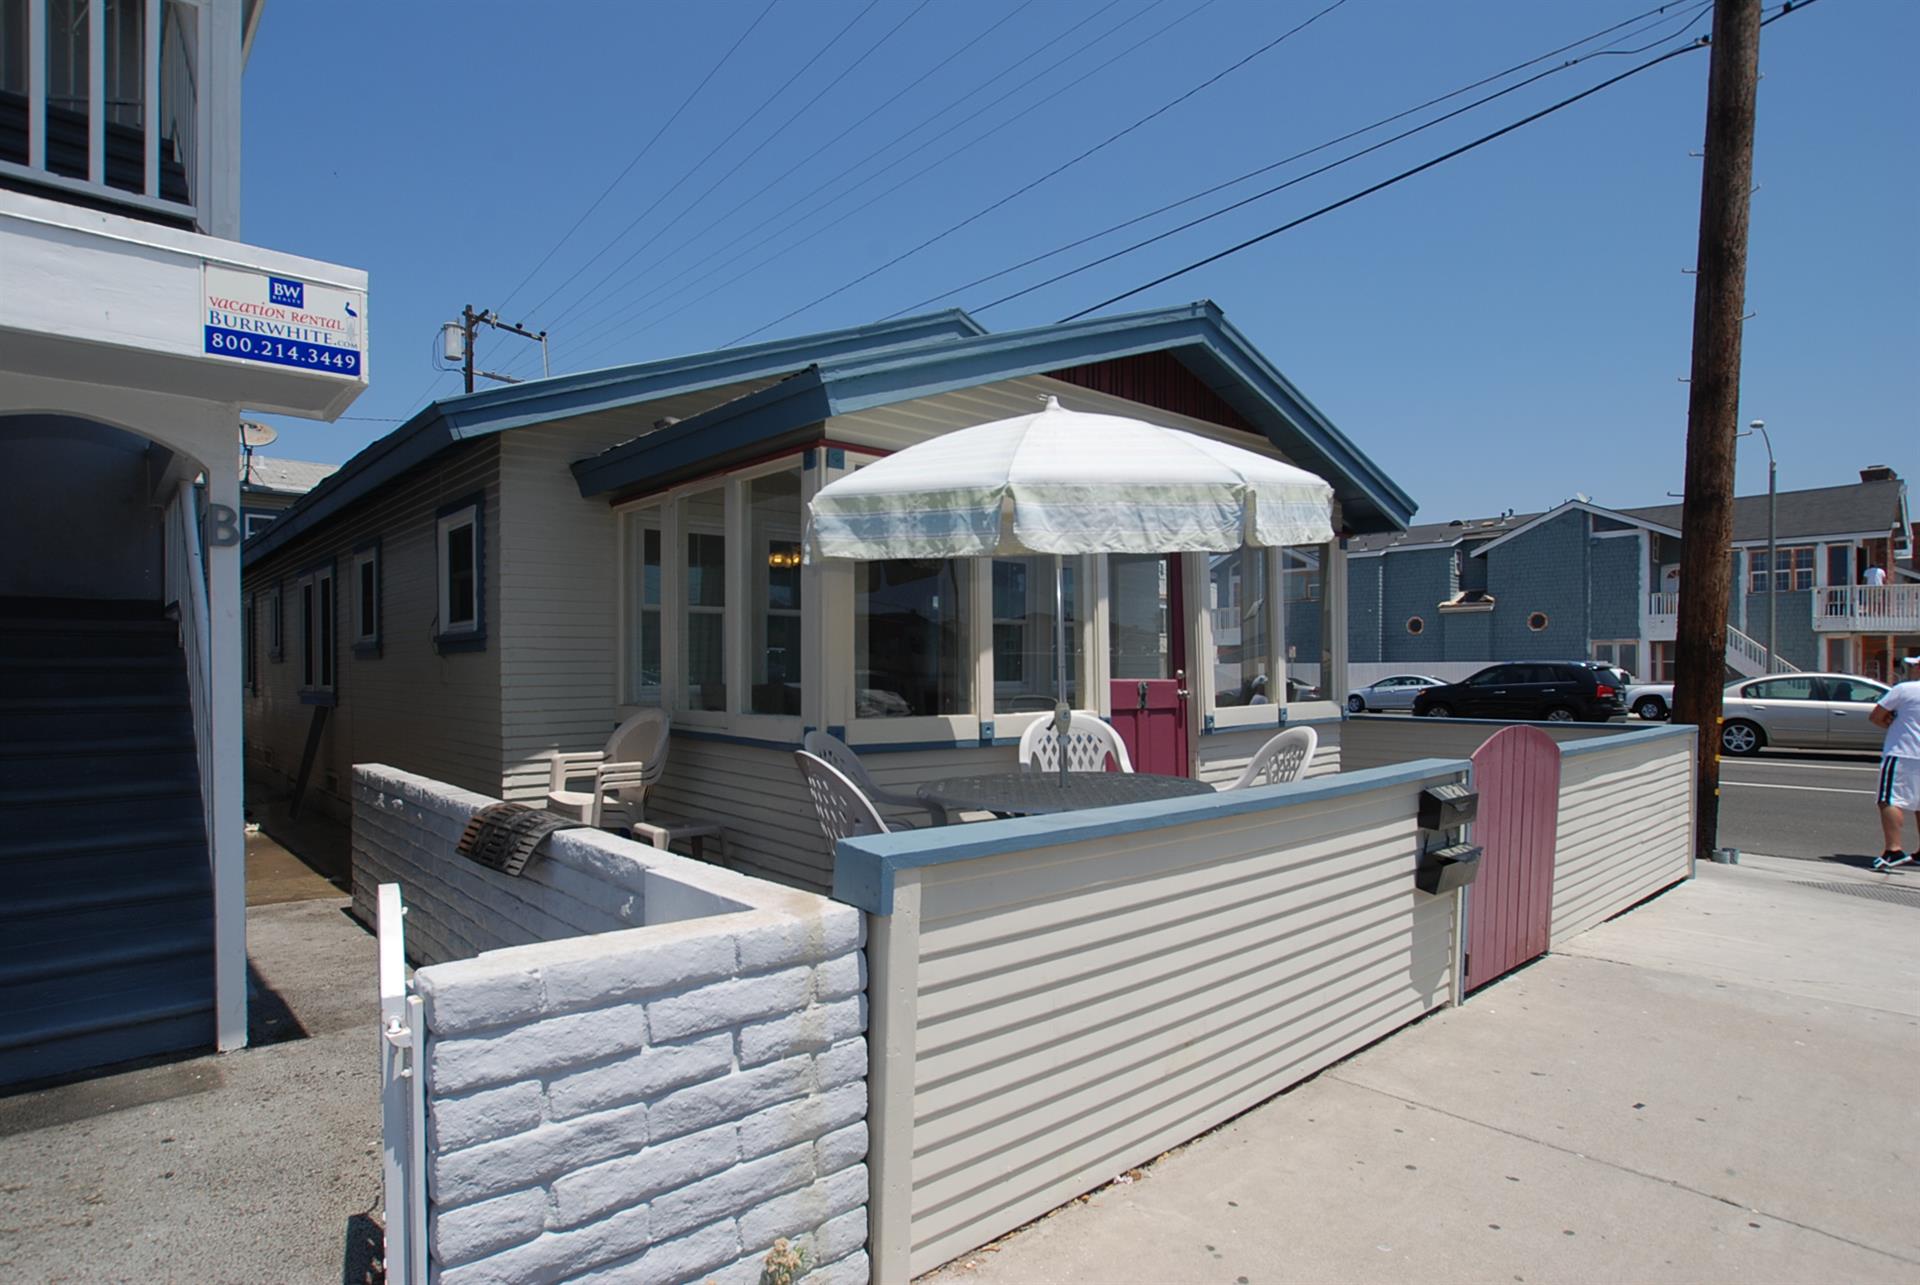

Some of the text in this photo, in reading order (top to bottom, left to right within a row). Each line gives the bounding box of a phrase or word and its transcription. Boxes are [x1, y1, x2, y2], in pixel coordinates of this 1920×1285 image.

[273, 282, 301, 299] BW
[212, 332, 356, 369] 800.214.3449
[208, 503, 240, 547] B
